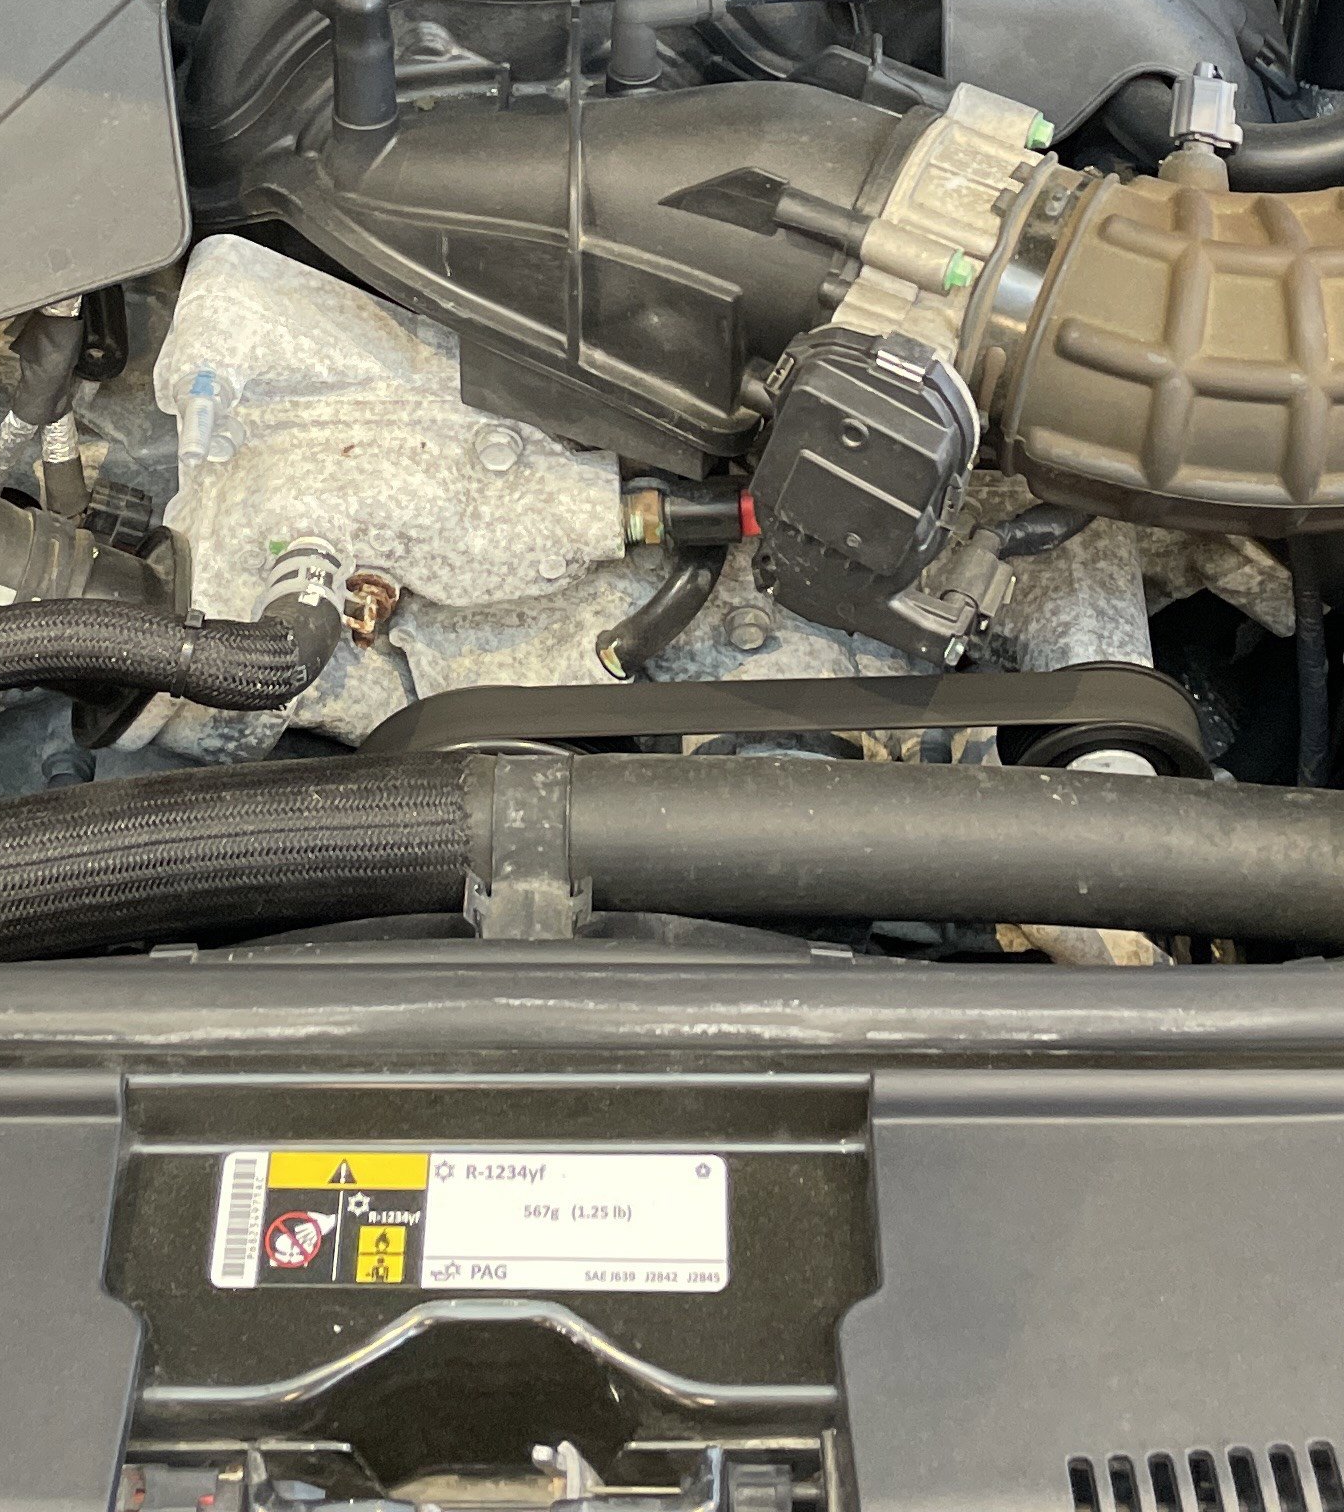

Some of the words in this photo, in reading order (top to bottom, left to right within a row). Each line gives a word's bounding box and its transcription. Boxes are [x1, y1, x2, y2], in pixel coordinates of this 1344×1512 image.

[464, 1163, 547, 1185] R-1234yf
[368, 1210, 422, 1226] R-1234yf
[523, 1204, 560, 1222] 567g
[571, 1204, 609, 1222] (1.25
[613, 1204, 633, 1222] lb)
[470, 1263, 508, 1281] PAG
[584, 1269, 607, 1282] SAE
